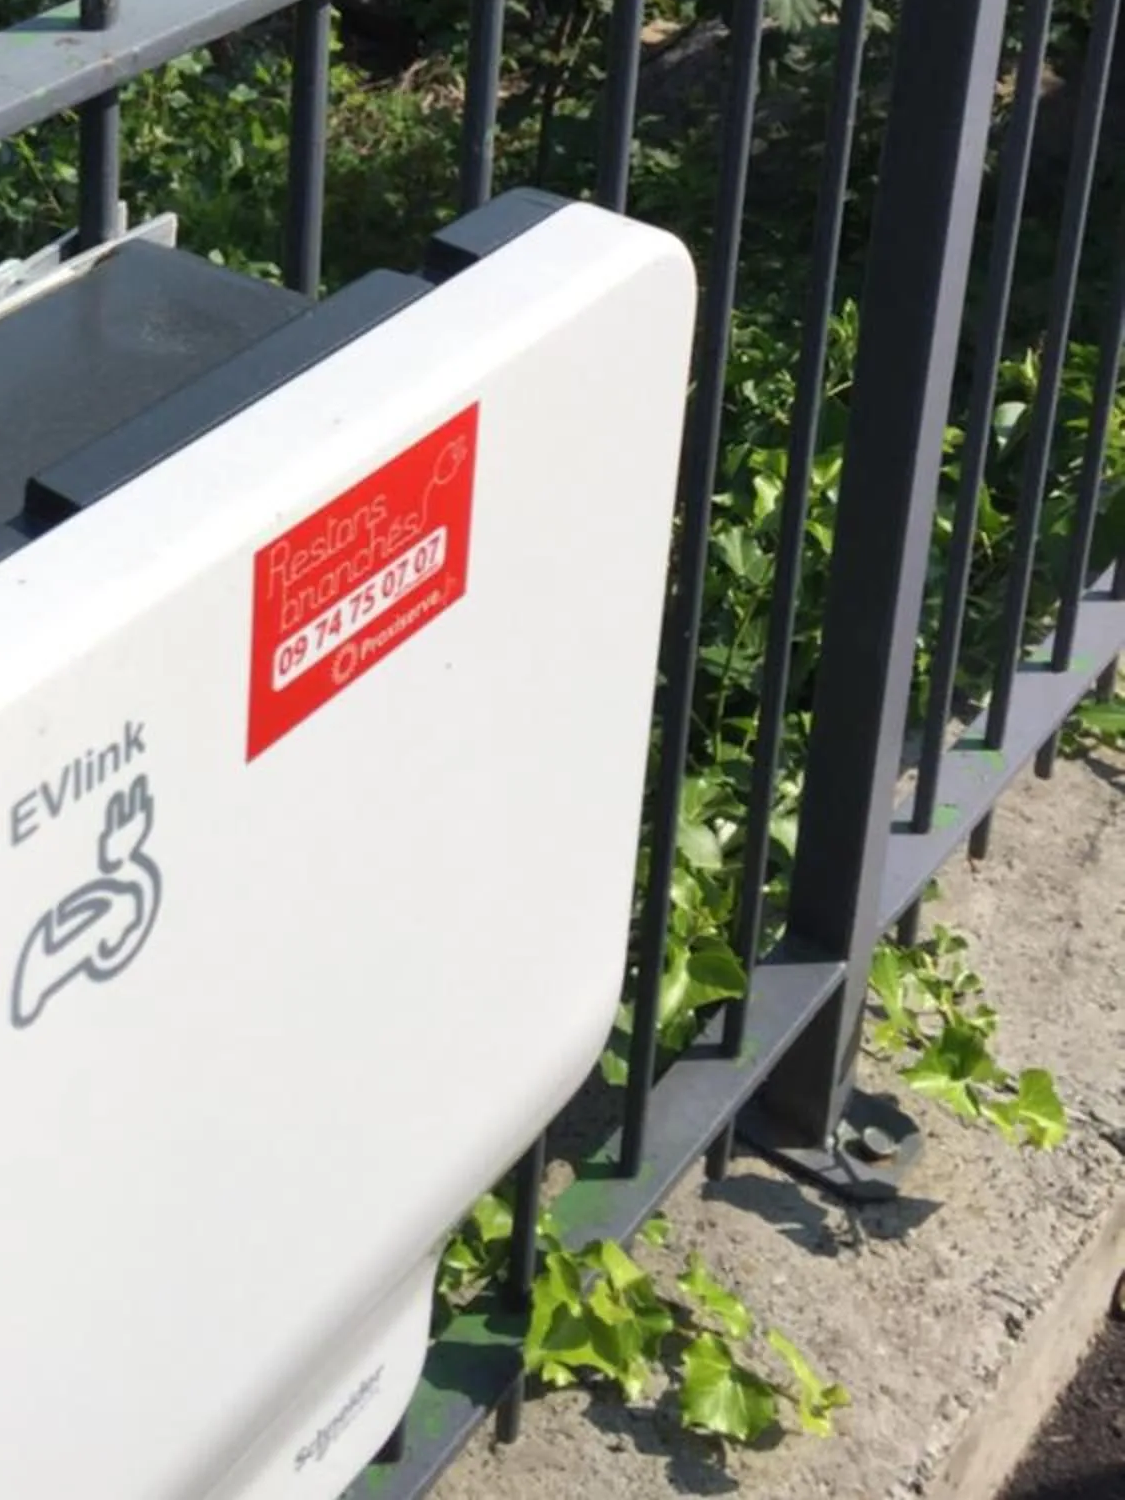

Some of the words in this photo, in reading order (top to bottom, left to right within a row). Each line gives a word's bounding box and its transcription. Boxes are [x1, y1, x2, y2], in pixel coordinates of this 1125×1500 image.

[267, 494, 387, 599] Restons
[278, 636, 308, 677] 09
[314, 609, 343, 652] 74
[348, 582, 376, 626] 75
[381, 559, 408, 599] 07
[413, 536, 442, 576] 07
[10, 721, 145, 847] EVlink
